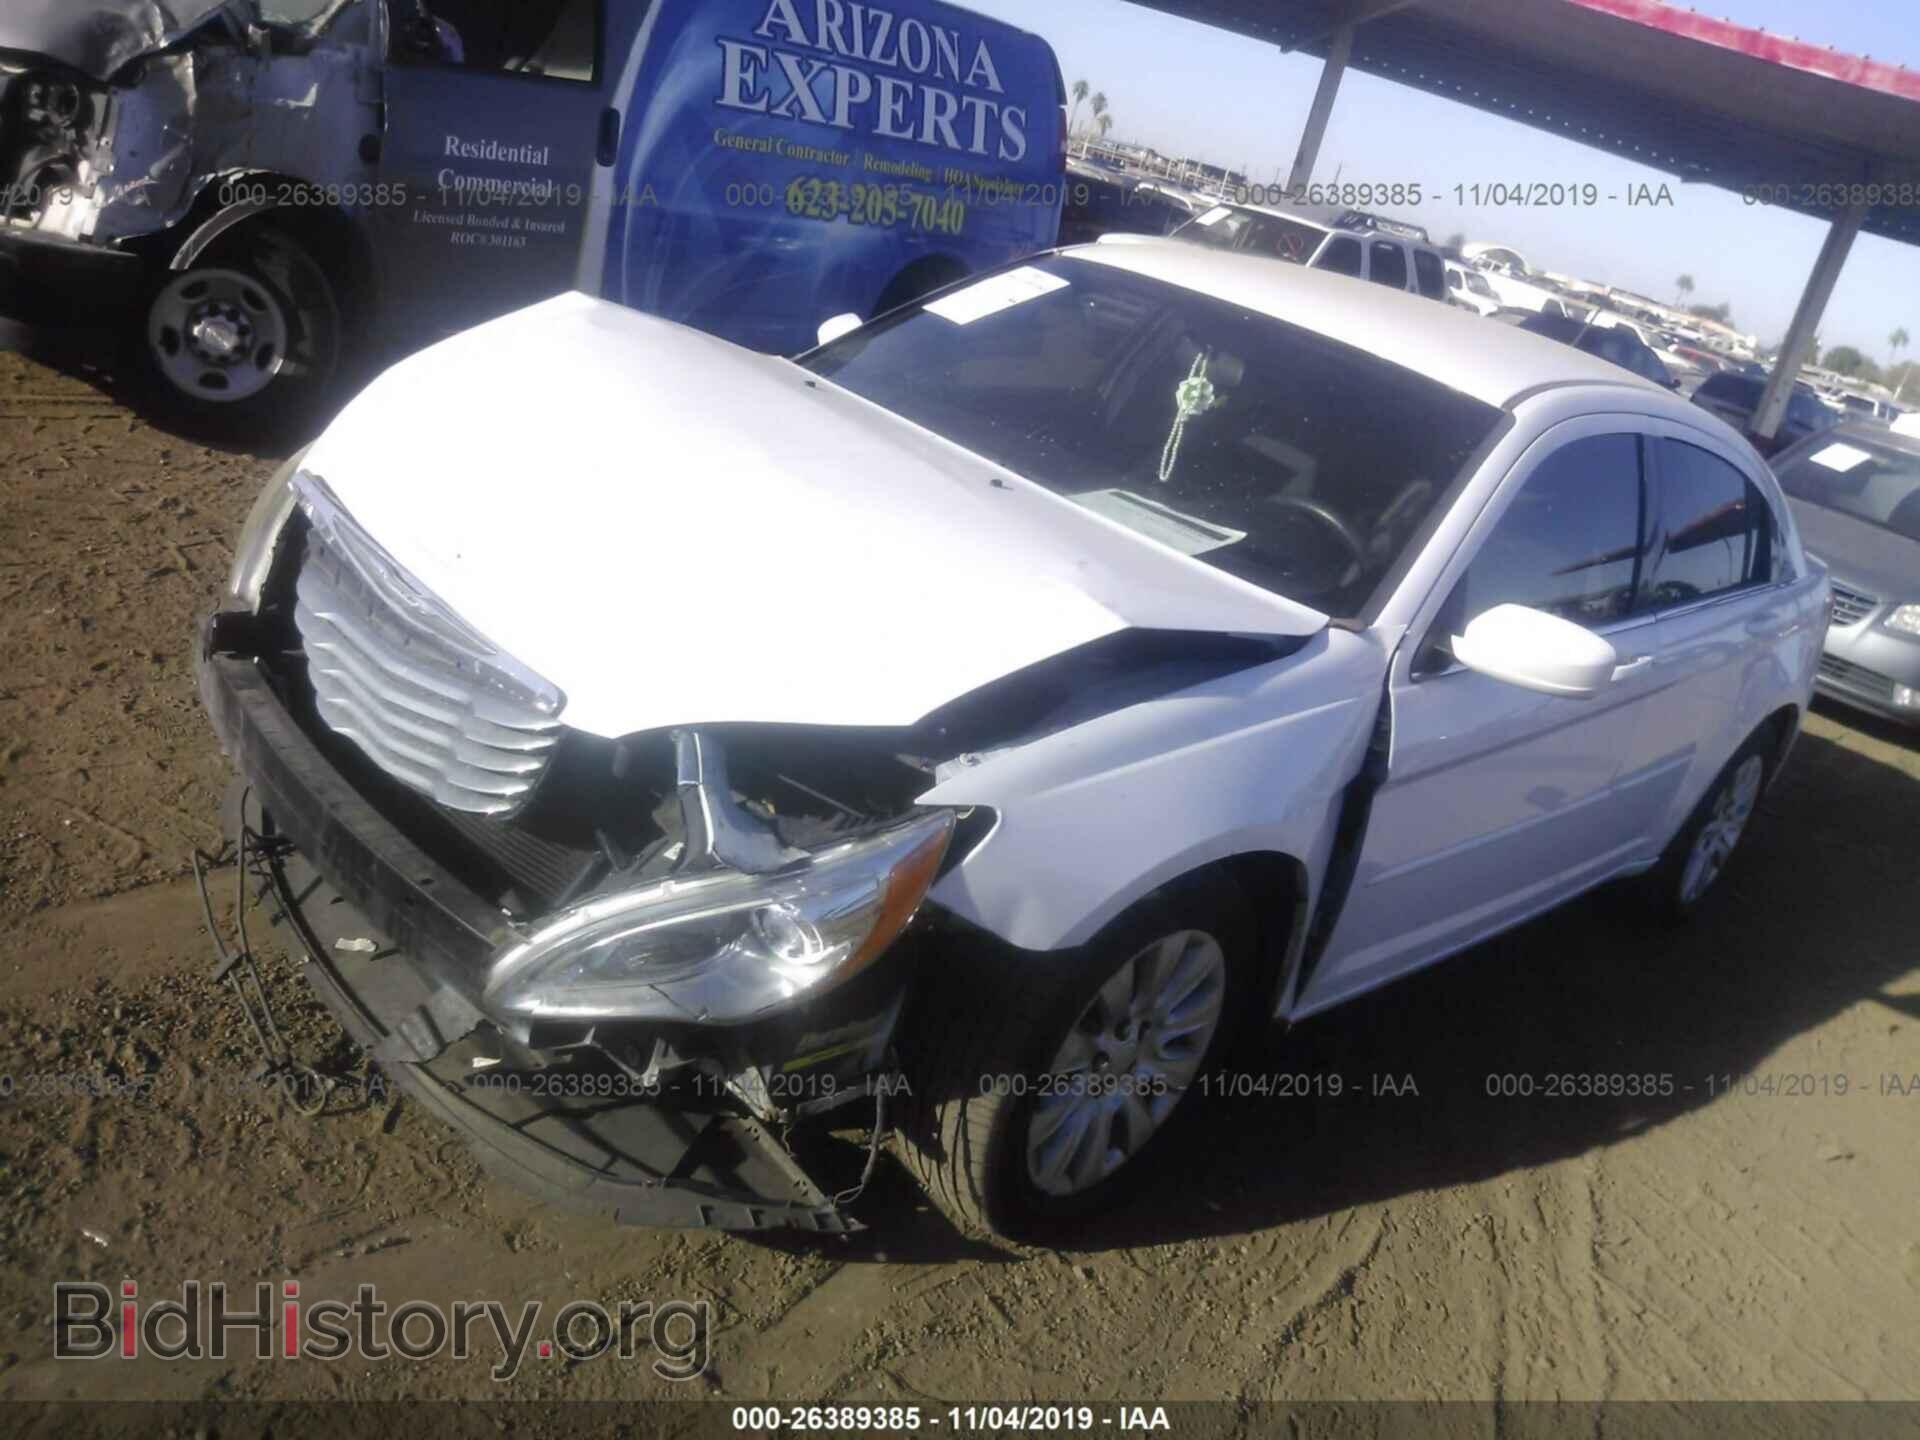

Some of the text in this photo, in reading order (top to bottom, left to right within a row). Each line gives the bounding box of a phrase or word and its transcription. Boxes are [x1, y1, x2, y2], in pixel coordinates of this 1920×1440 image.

[754, 0, 1004, 94] ARIZONA
[716, 39, 1027, 162] EXPERTS
[445, 135, 549, 166] Residential
[713, 128, 773, 154] General
[775, 138, 849, 167] Contractor
[437, 168, 553, 198] Commercial
[787, 175, 965, 235] 623-205-7040
